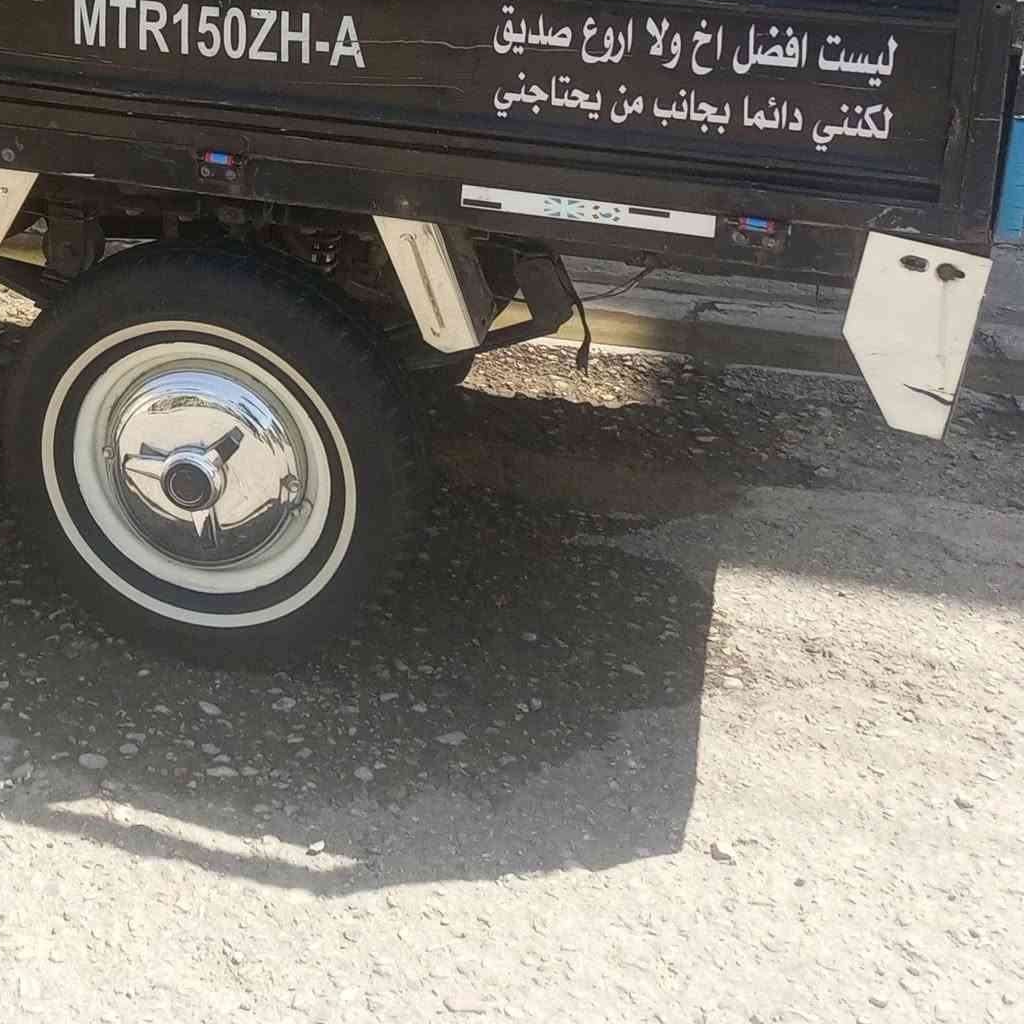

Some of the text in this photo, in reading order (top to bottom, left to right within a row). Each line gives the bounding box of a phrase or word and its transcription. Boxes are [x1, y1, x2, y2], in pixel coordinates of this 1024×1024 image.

[493, 5, 898, 87] ليست افضل اخ ولا اروع صديق
[493, 71, 894, 153] لكنني دائما بجانب من يحتاجني
